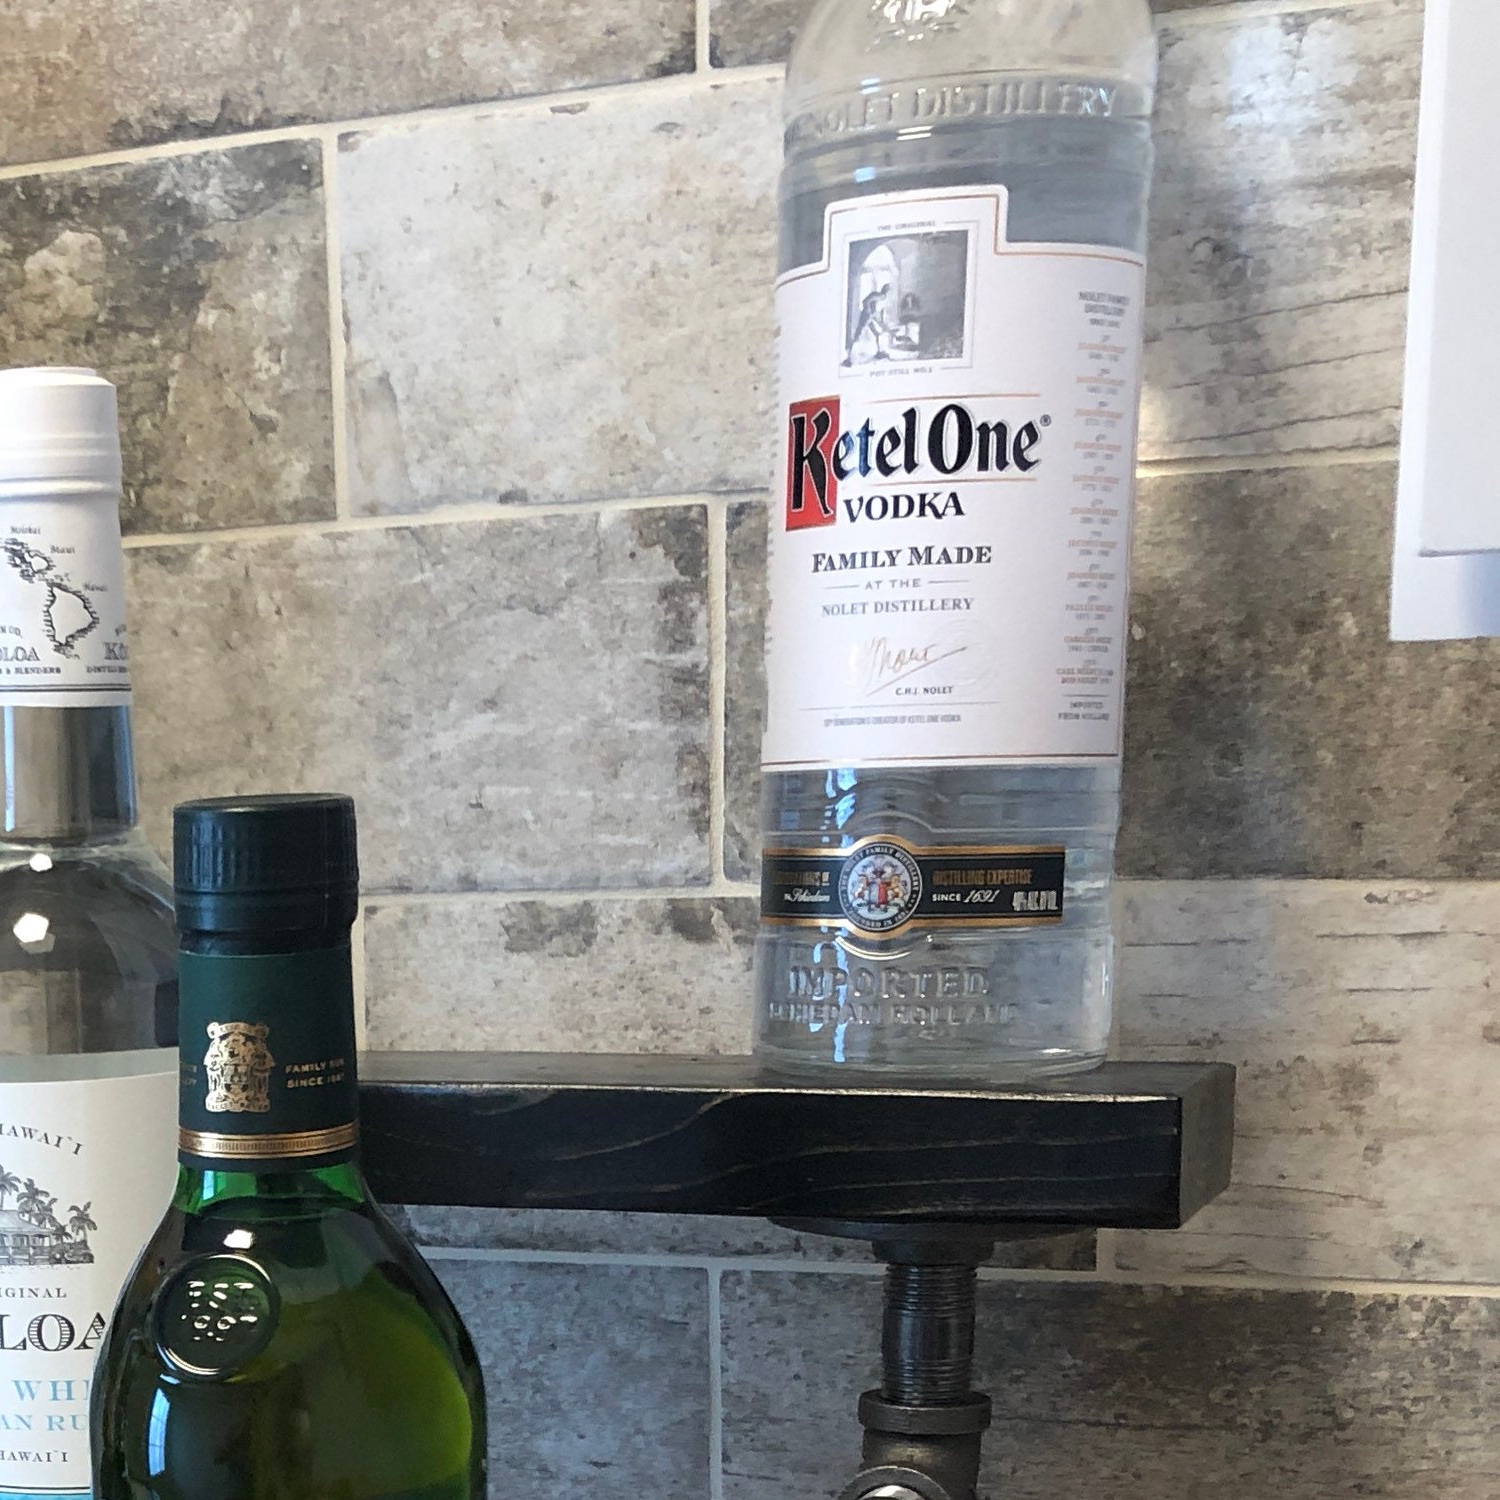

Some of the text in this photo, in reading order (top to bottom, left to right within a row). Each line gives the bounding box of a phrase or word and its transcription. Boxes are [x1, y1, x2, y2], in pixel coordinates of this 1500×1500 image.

[790, 405, 920, 518] Ketel
[842, 490, 966, 524] VODKA
[811, 544, 993, 574] FAMILY MADE
[864, 577, 923, 591] AT THE
[821, 597, 976, 618] NOLET DISTILLERY
[922, 685, 955, 696] NOLET
[931, 893, 962, 902] SINCE
[285, 1061, 327, 1075] FAMILY
[286, 1077, 325, 1089] SINCE
